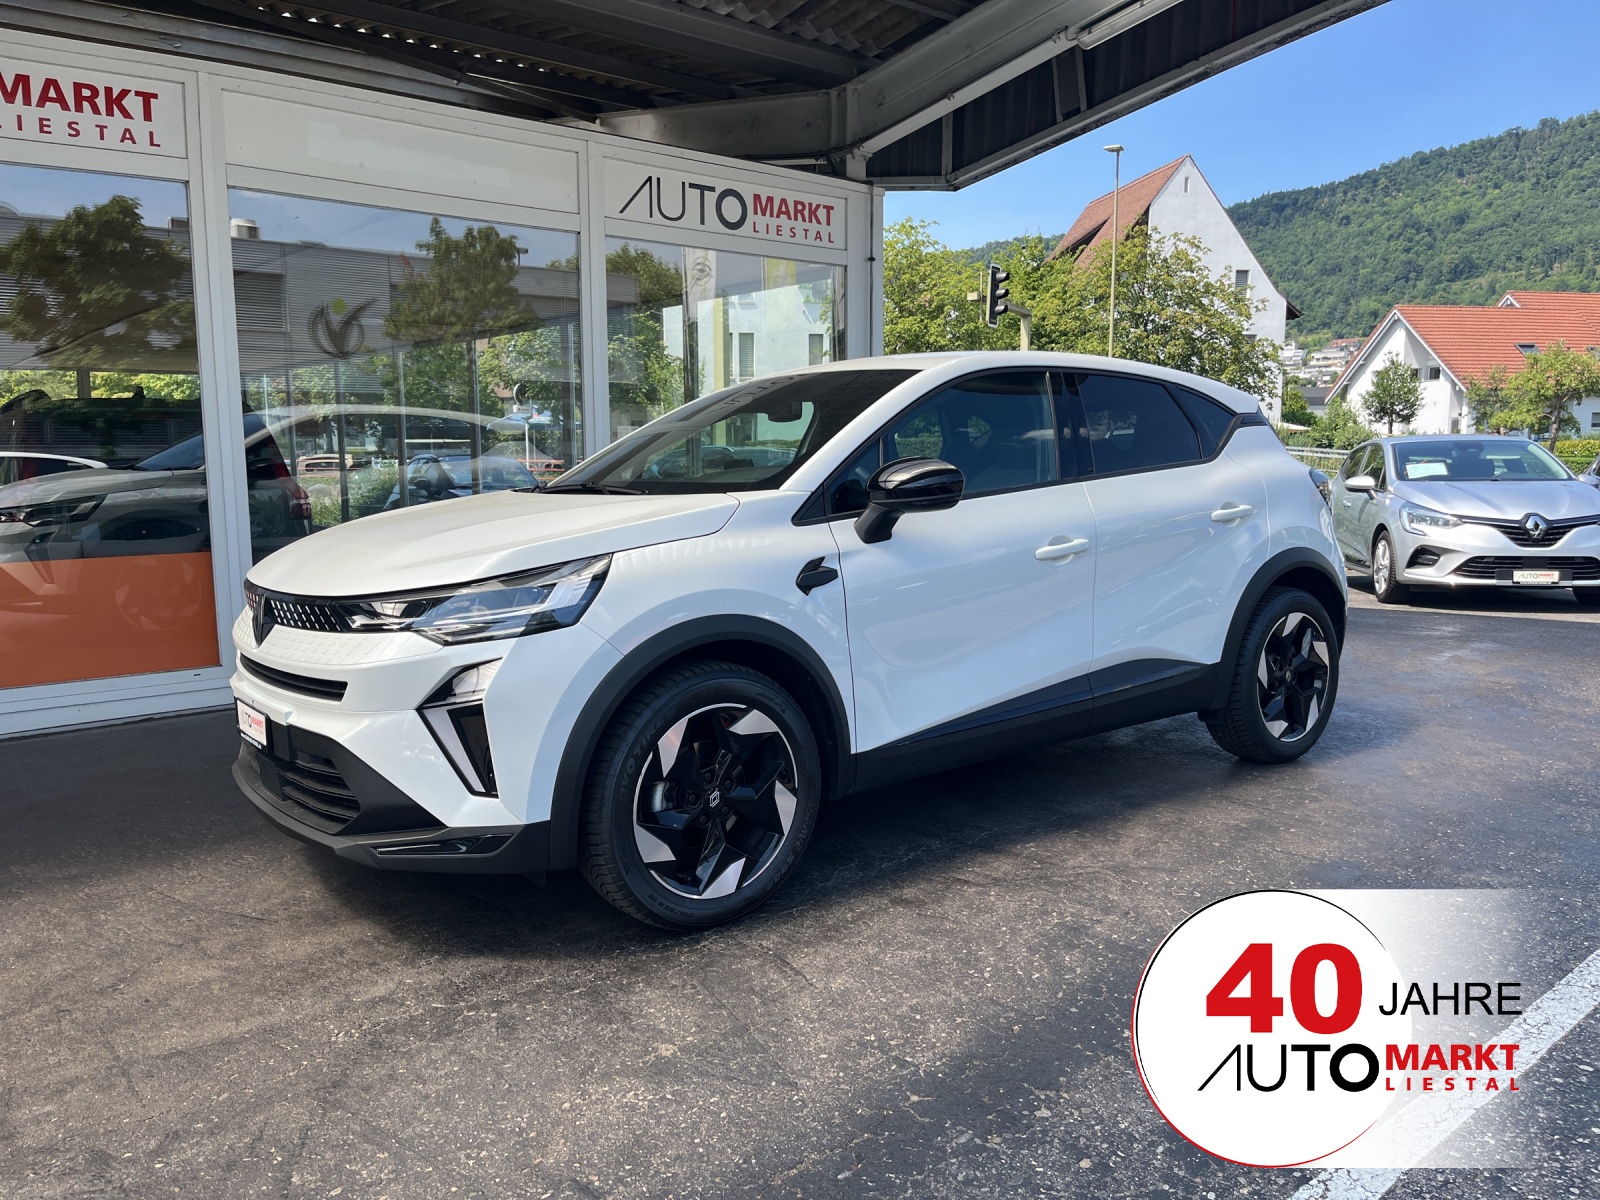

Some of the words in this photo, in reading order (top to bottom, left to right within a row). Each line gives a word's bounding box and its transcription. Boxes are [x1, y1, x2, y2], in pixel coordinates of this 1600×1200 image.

[0, 71, 159, 123] MARKT
[0, 114, 161, 148] IESTAL
[618, 175, 748, 231] AUTO
[752, 193, 835, 227] MARKT
[752, 221, 835, 244] LIESTAL
